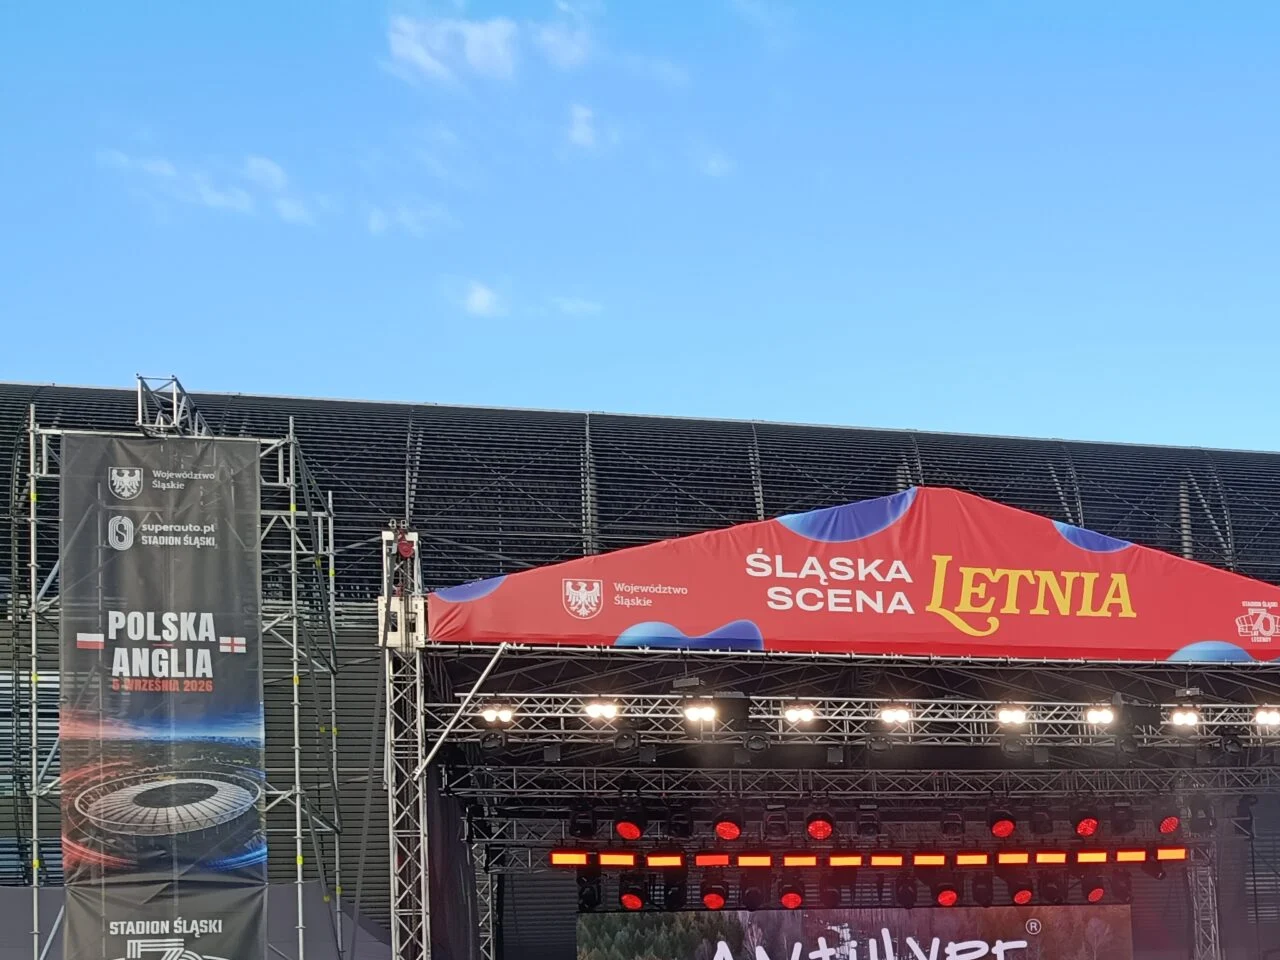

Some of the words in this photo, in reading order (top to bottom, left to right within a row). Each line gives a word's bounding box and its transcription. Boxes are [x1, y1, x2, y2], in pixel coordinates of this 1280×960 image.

[152, 469, 216, 482] Województwo
[152, 480, 185, 490] Śląskie
[141, 523, 215, 534] superauto.pl
[141, 536, 181, 546] STADION
[183, 534, 216, 548] ŚLĄSKI
[746, 548, 913, 584] ŚLĄSKA
[613, 582, 688, 595] Województwo
[614, 595, 652, 608] Śląskie
[767, 587, 916, 614] SCENA
[926, 555, 1137, 637] LETNIA
[108, 610, 216, 642] POLSKA
[112, 647, 213, 678] ANGLIA
[183, 680, 213, 692] 2026
[109, 921, 169, 935] STADION
[173, 917, 222, 937] ŚLĄSKI
